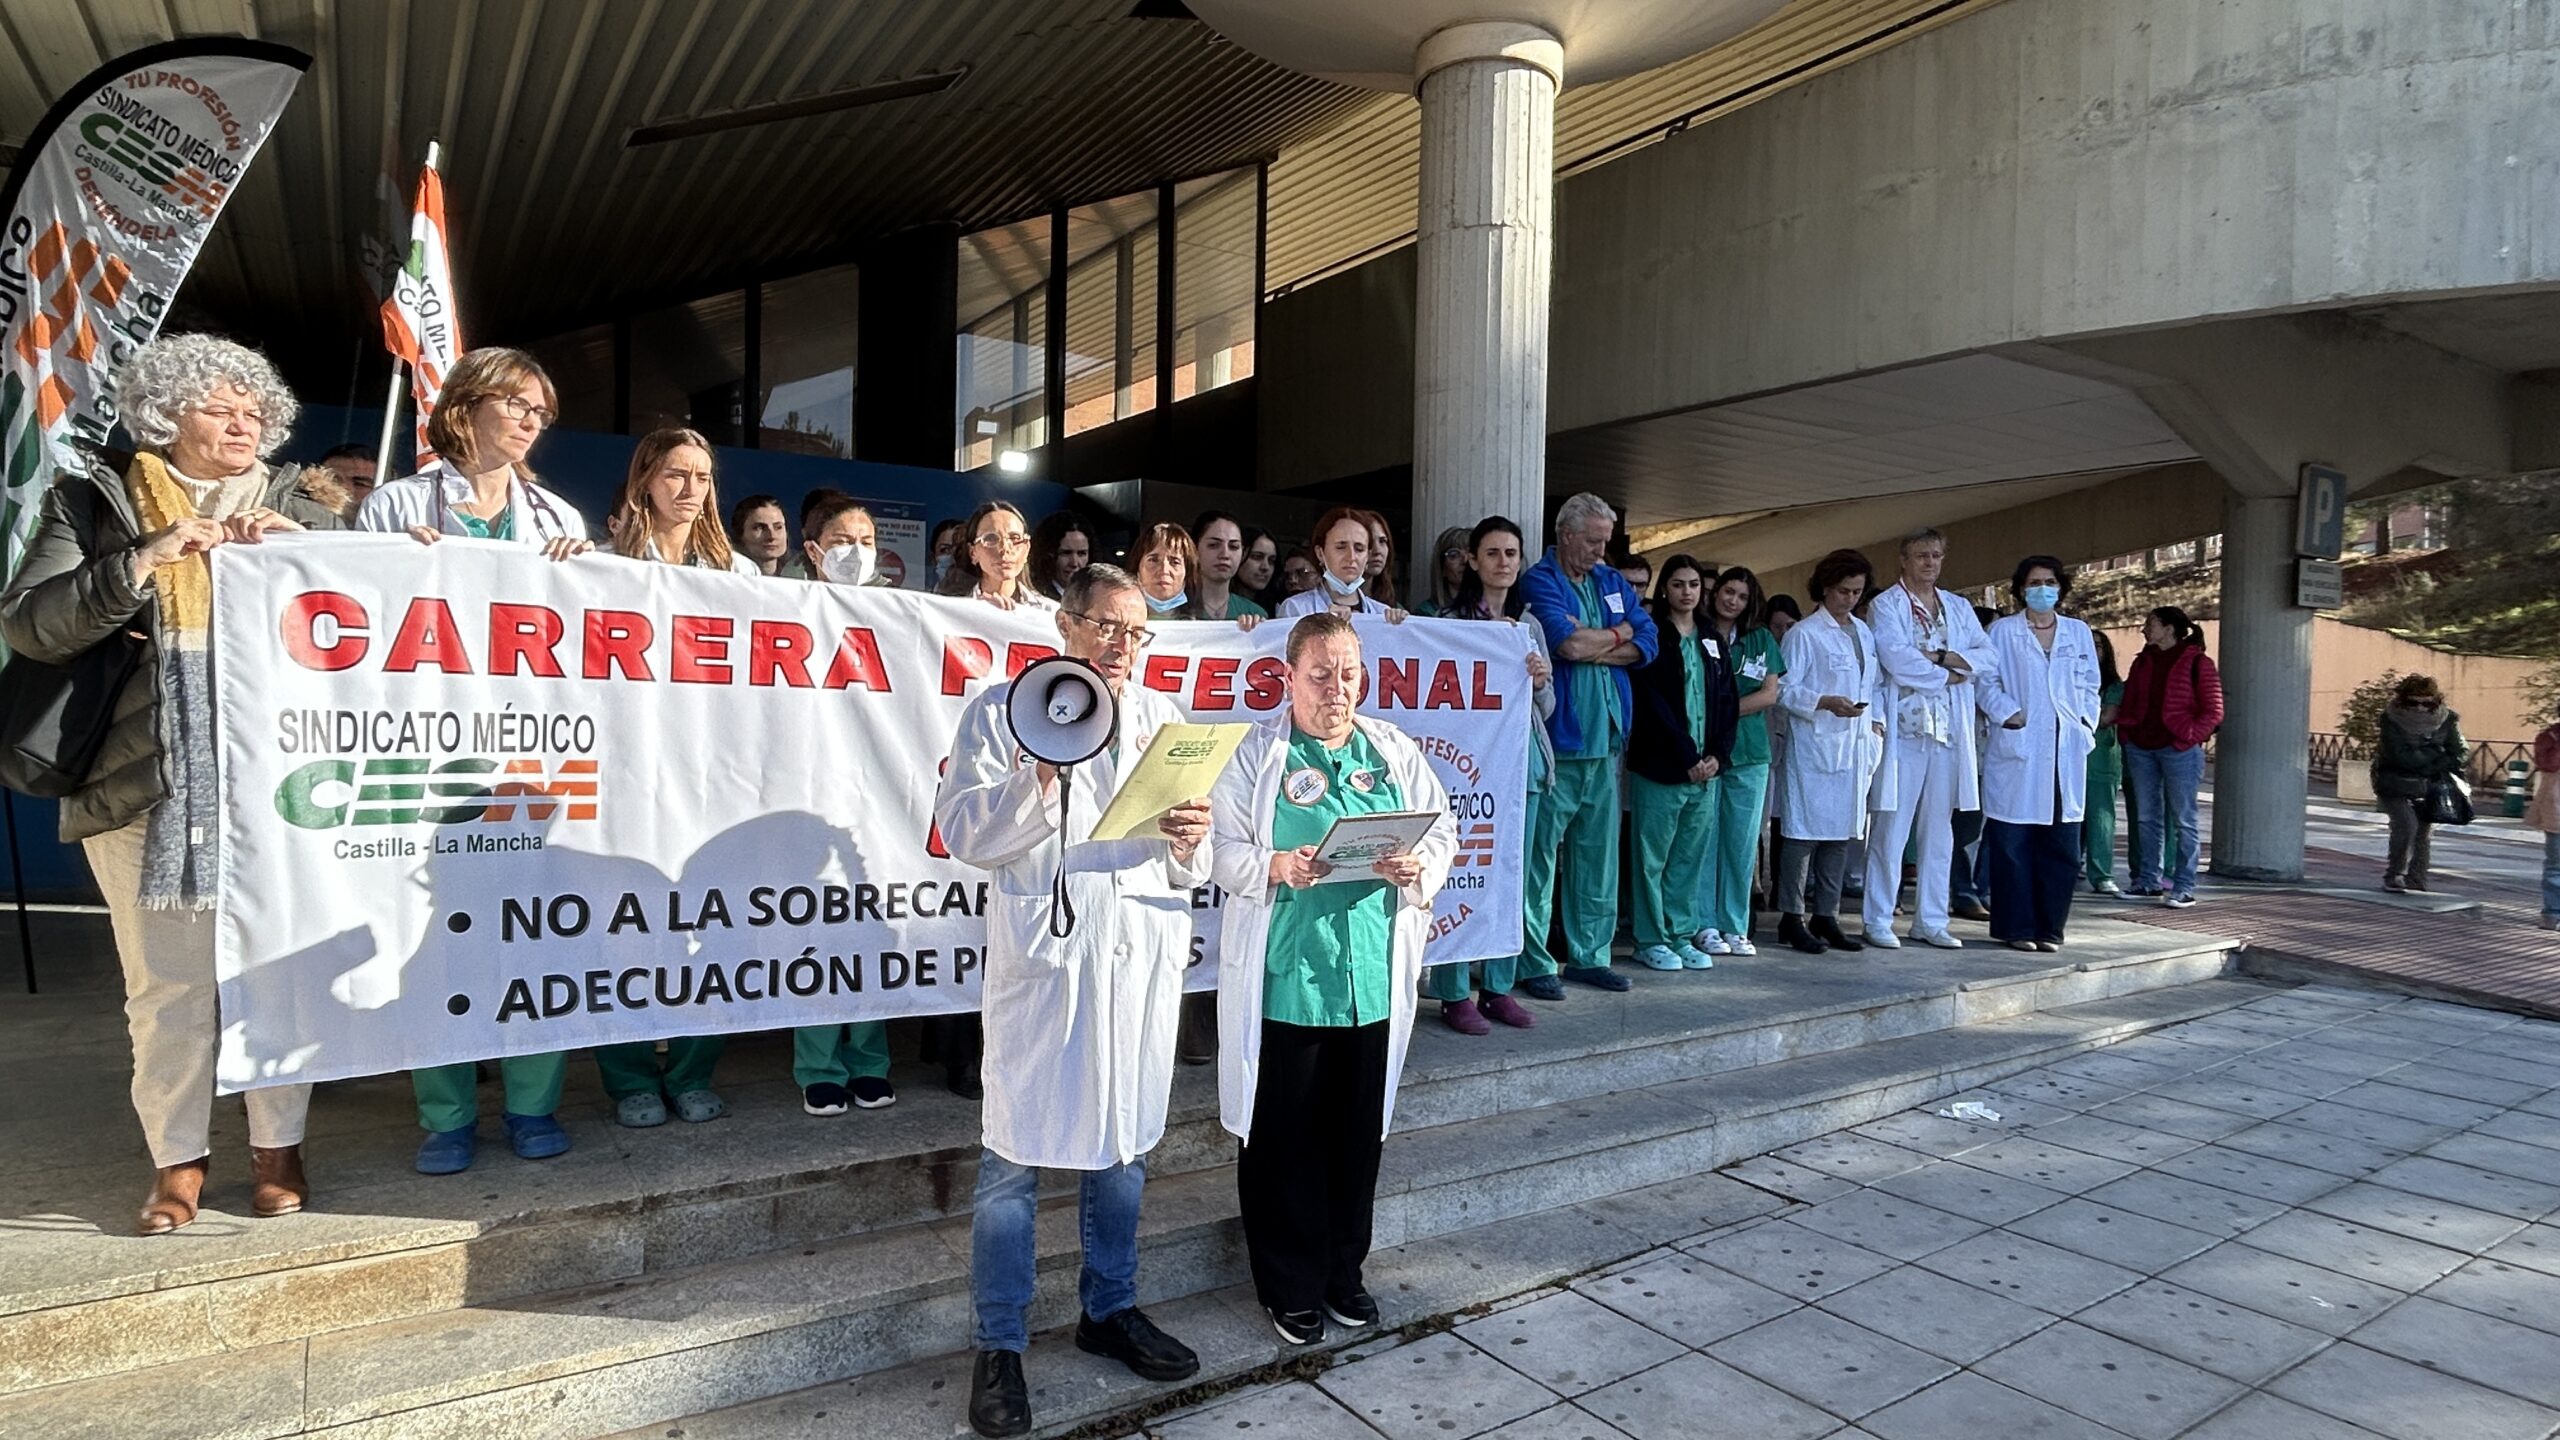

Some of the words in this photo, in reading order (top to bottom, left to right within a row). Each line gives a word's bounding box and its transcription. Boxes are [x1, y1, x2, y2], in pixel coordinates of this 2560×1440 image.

[96, 86, 181, 147] SINDICATO
[179, 138, 240, 183] MÉDICO
[124, 71, 151, 90] TU
[155, 71, 241, 152] PROFESIÓN
[2312, 477, 2335, 545] P
[279, 590, 892, 692] CARRERA
[278, 707, 461, 754] SINDICATO
[472, 702, 596, 754] MÉDICO
[274, 758, 598, 830] CESM
[1450, 787, 1495, 820] ÉDICO
[334, 837, 416, 860] Castilla
[434, 836, 458, 855] La
[466, 834, 543, 854] Mancha
[501, 893, 590, 942] NO
[607, 892, 650, 934] A
[668, 888, 734, 931] LA
[495, 946, 863, 1024] ADECUACIÓN
[880, 949, 938, 990] DE
